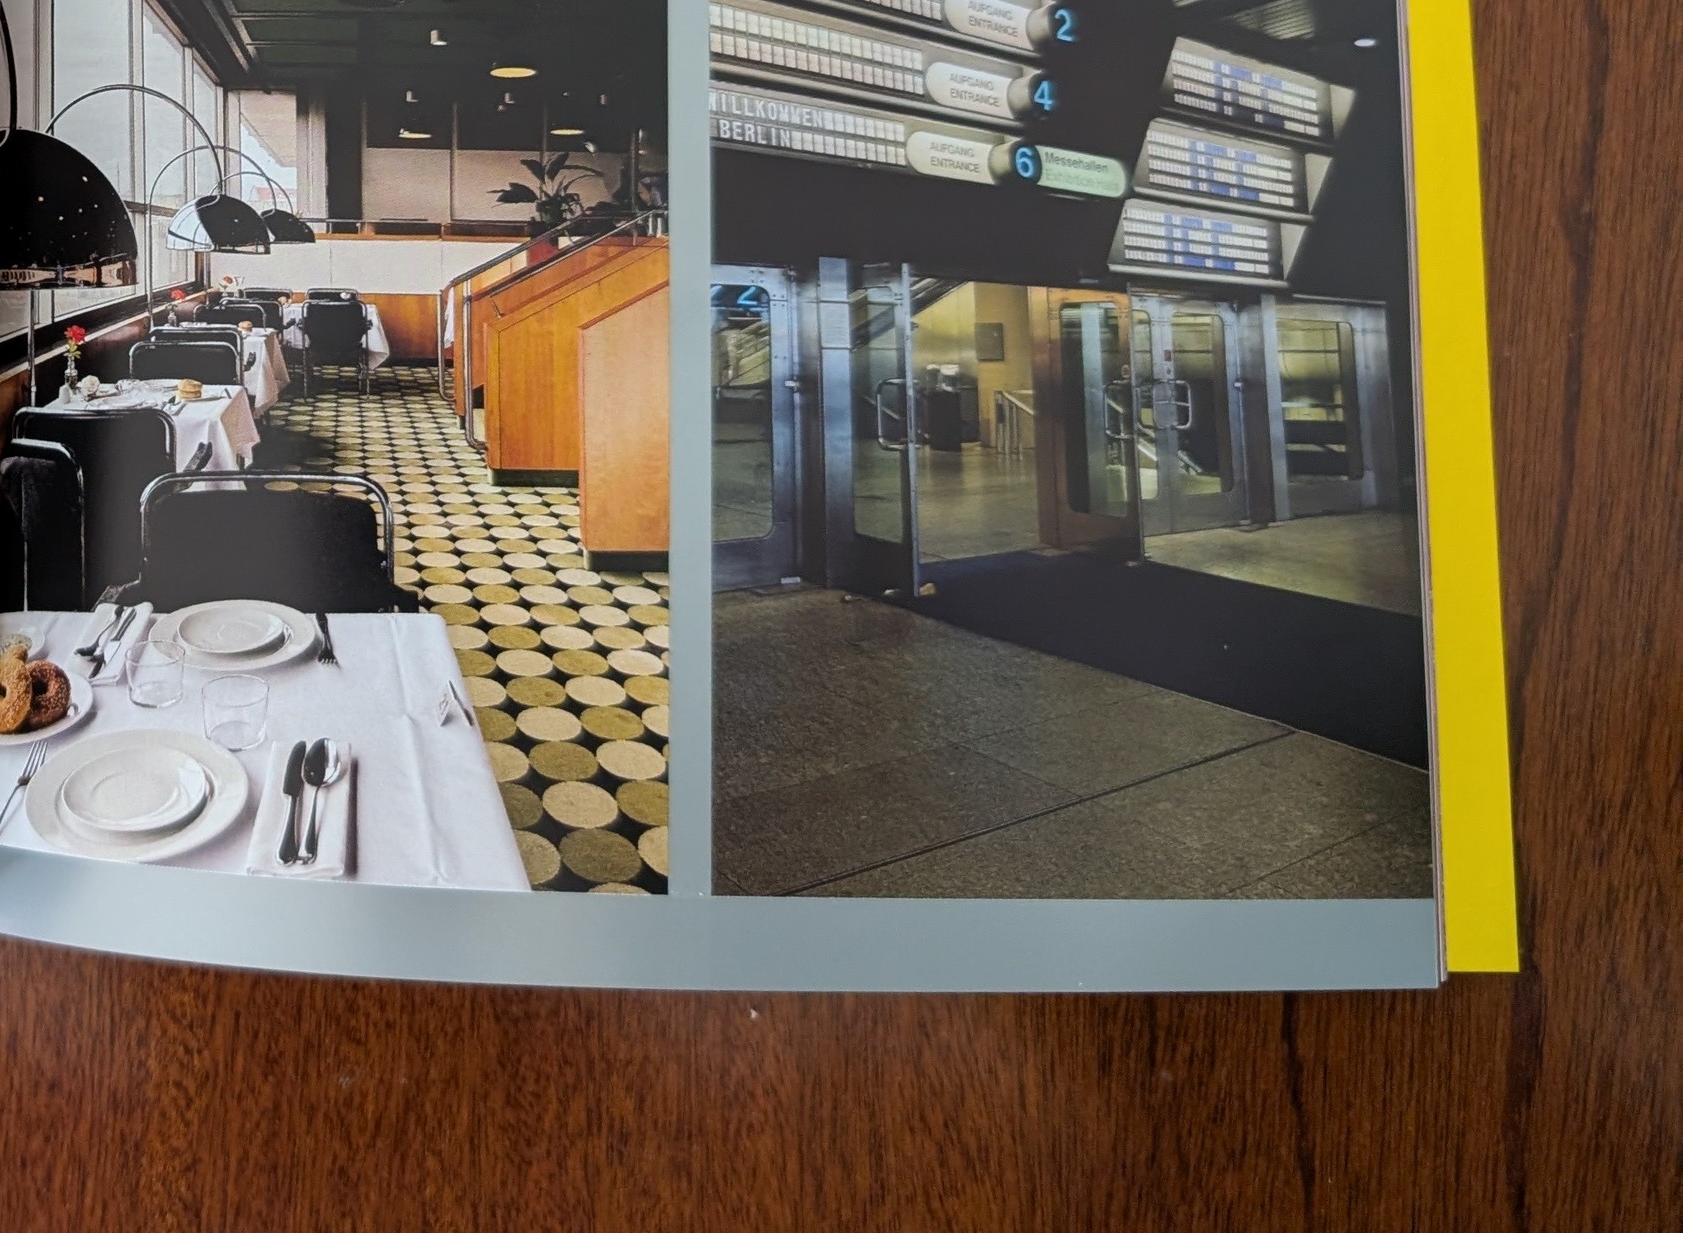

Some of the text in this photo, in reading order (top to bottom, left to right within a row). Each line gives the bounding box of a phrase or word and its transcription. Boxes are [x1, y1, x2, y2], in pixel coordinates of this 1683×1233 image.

[969, 15, 1018, 38] ENTRANCE
[1054, 9, 1076, 41] 2
[950, 88, 1000, 107] ENTRANCE
[1034, 80, 1055, 111] 4
[719, 119, 791, 148] BERLIN
[931, 157, 979, 174] ENTRANCE
[1016, 148, 1036, 178] 6
